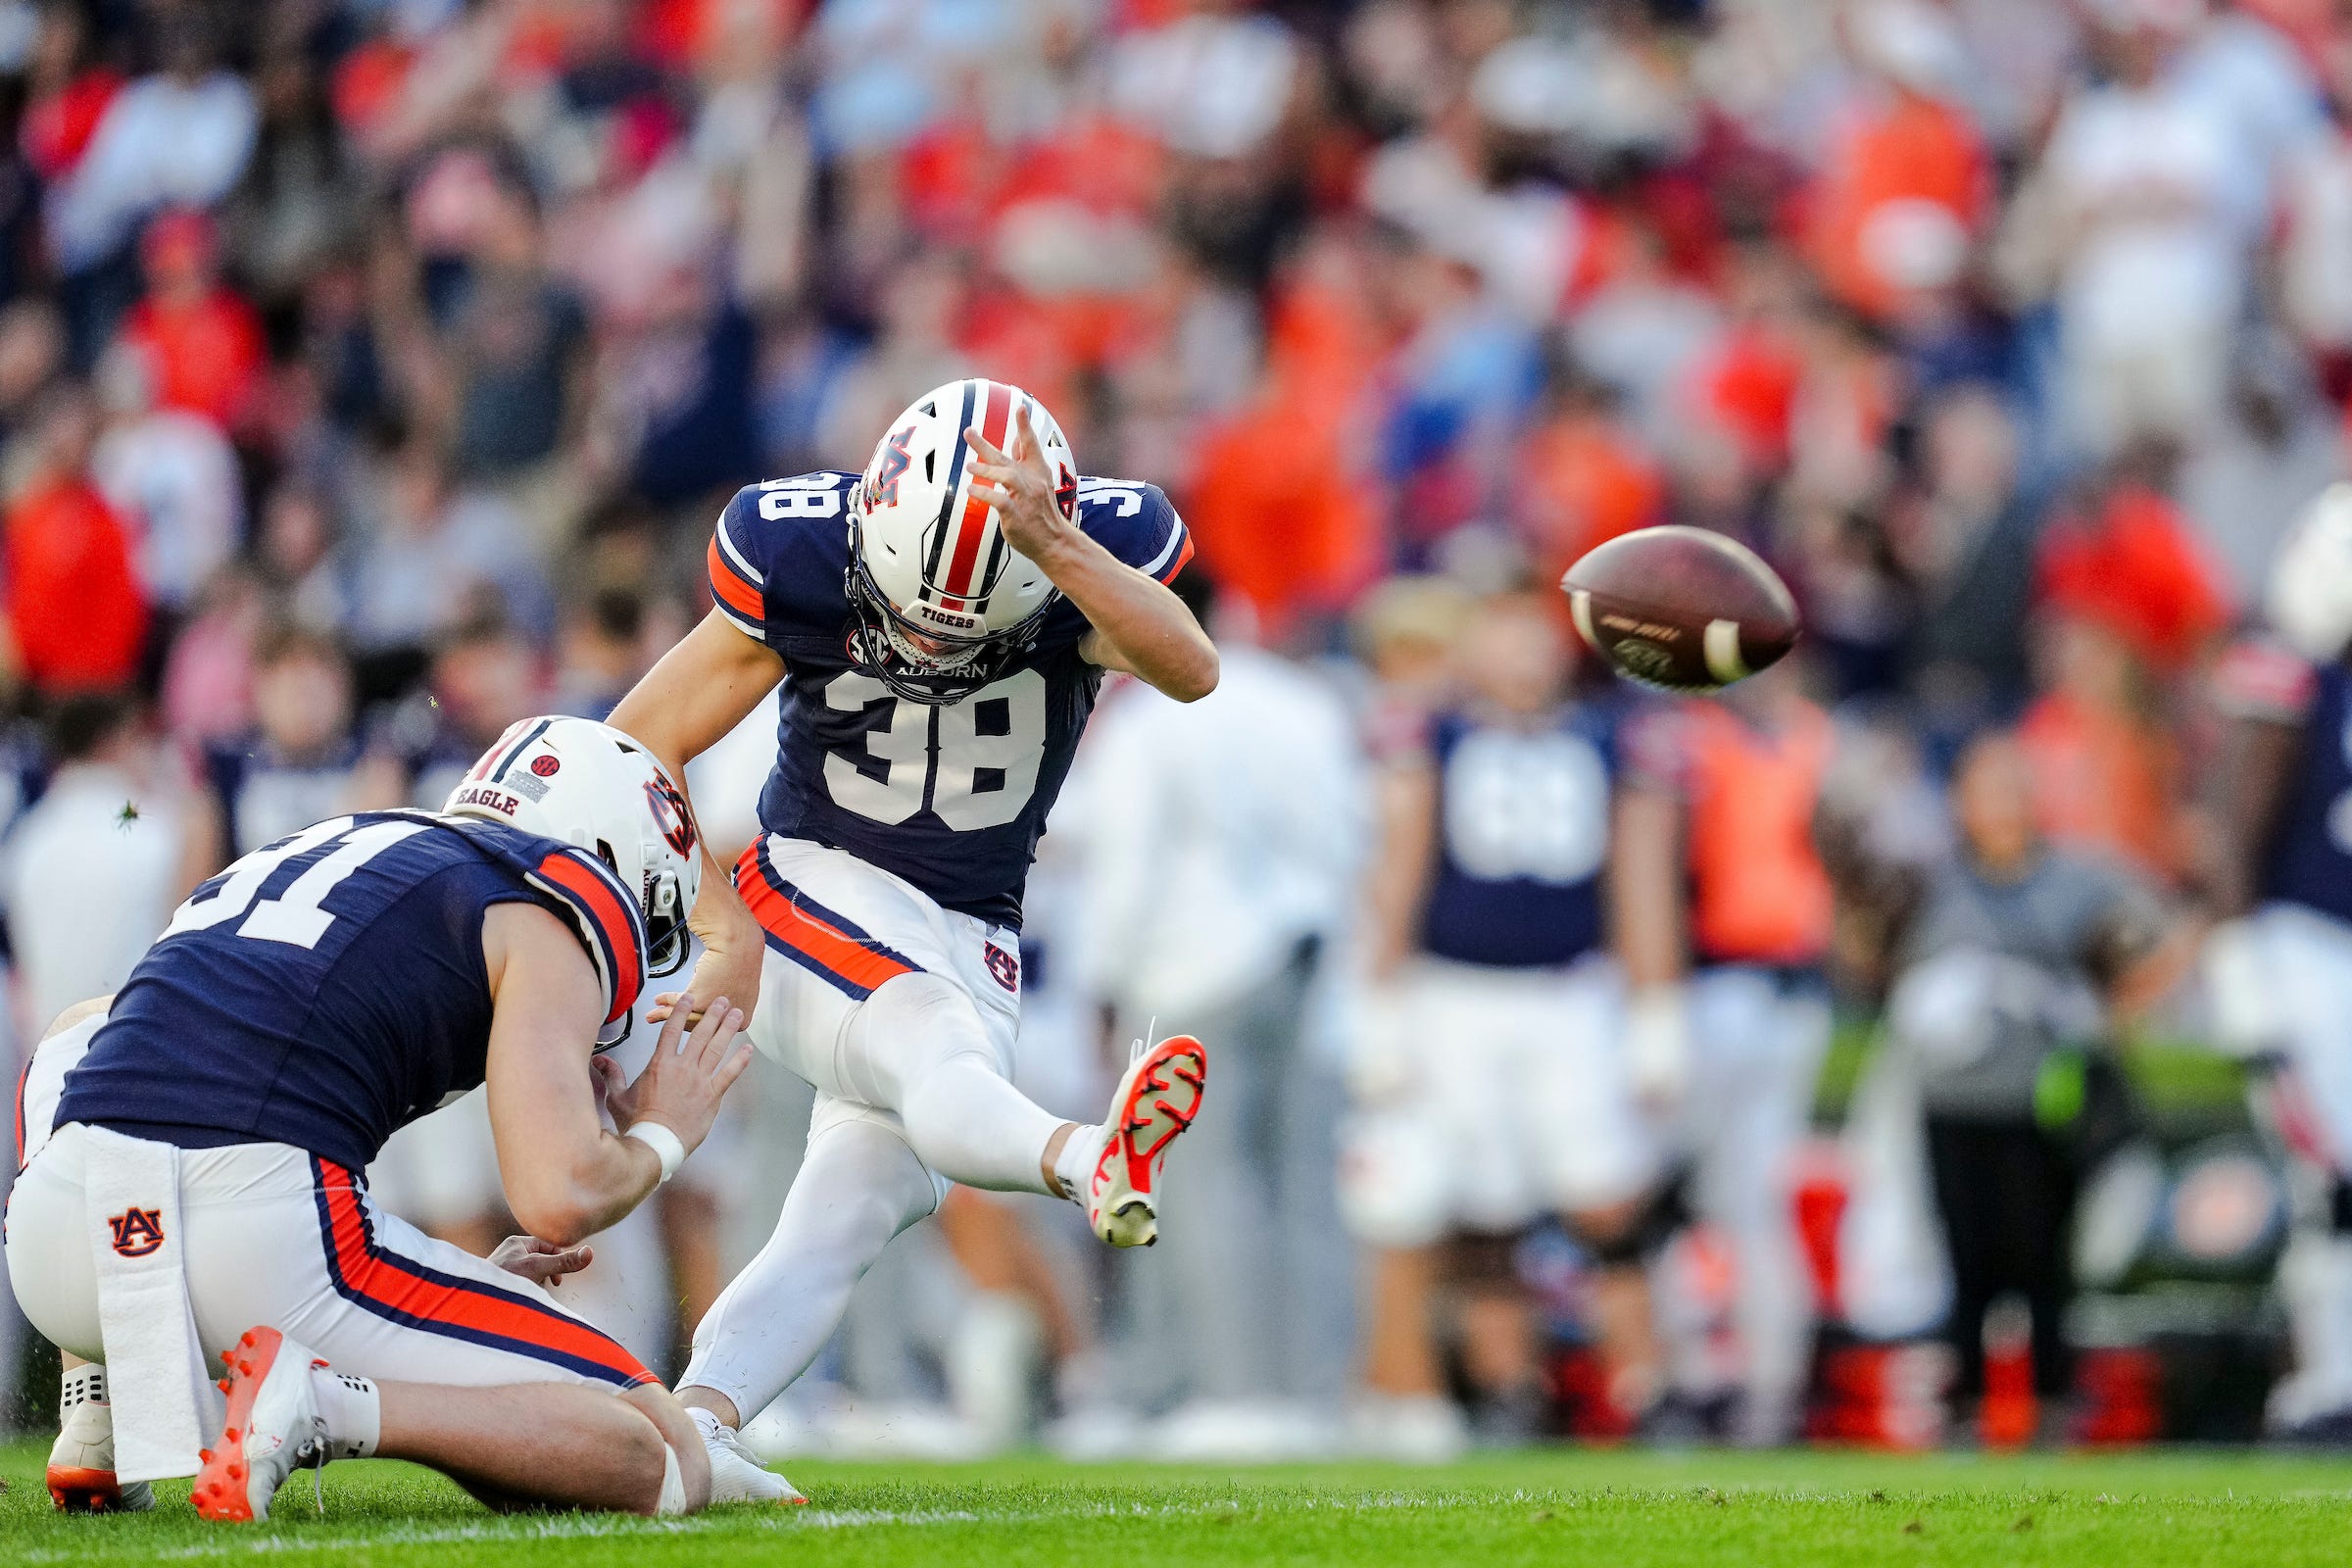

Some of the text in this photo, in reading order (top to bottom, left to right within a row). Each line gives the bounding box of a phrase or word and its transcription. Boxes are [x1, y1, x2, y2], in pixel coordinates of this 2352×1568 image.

[921, 606, 975, 629] TIGERS
[822, 668, 1047, 832] 38
[455, 788, 520, 816] EAGLE
